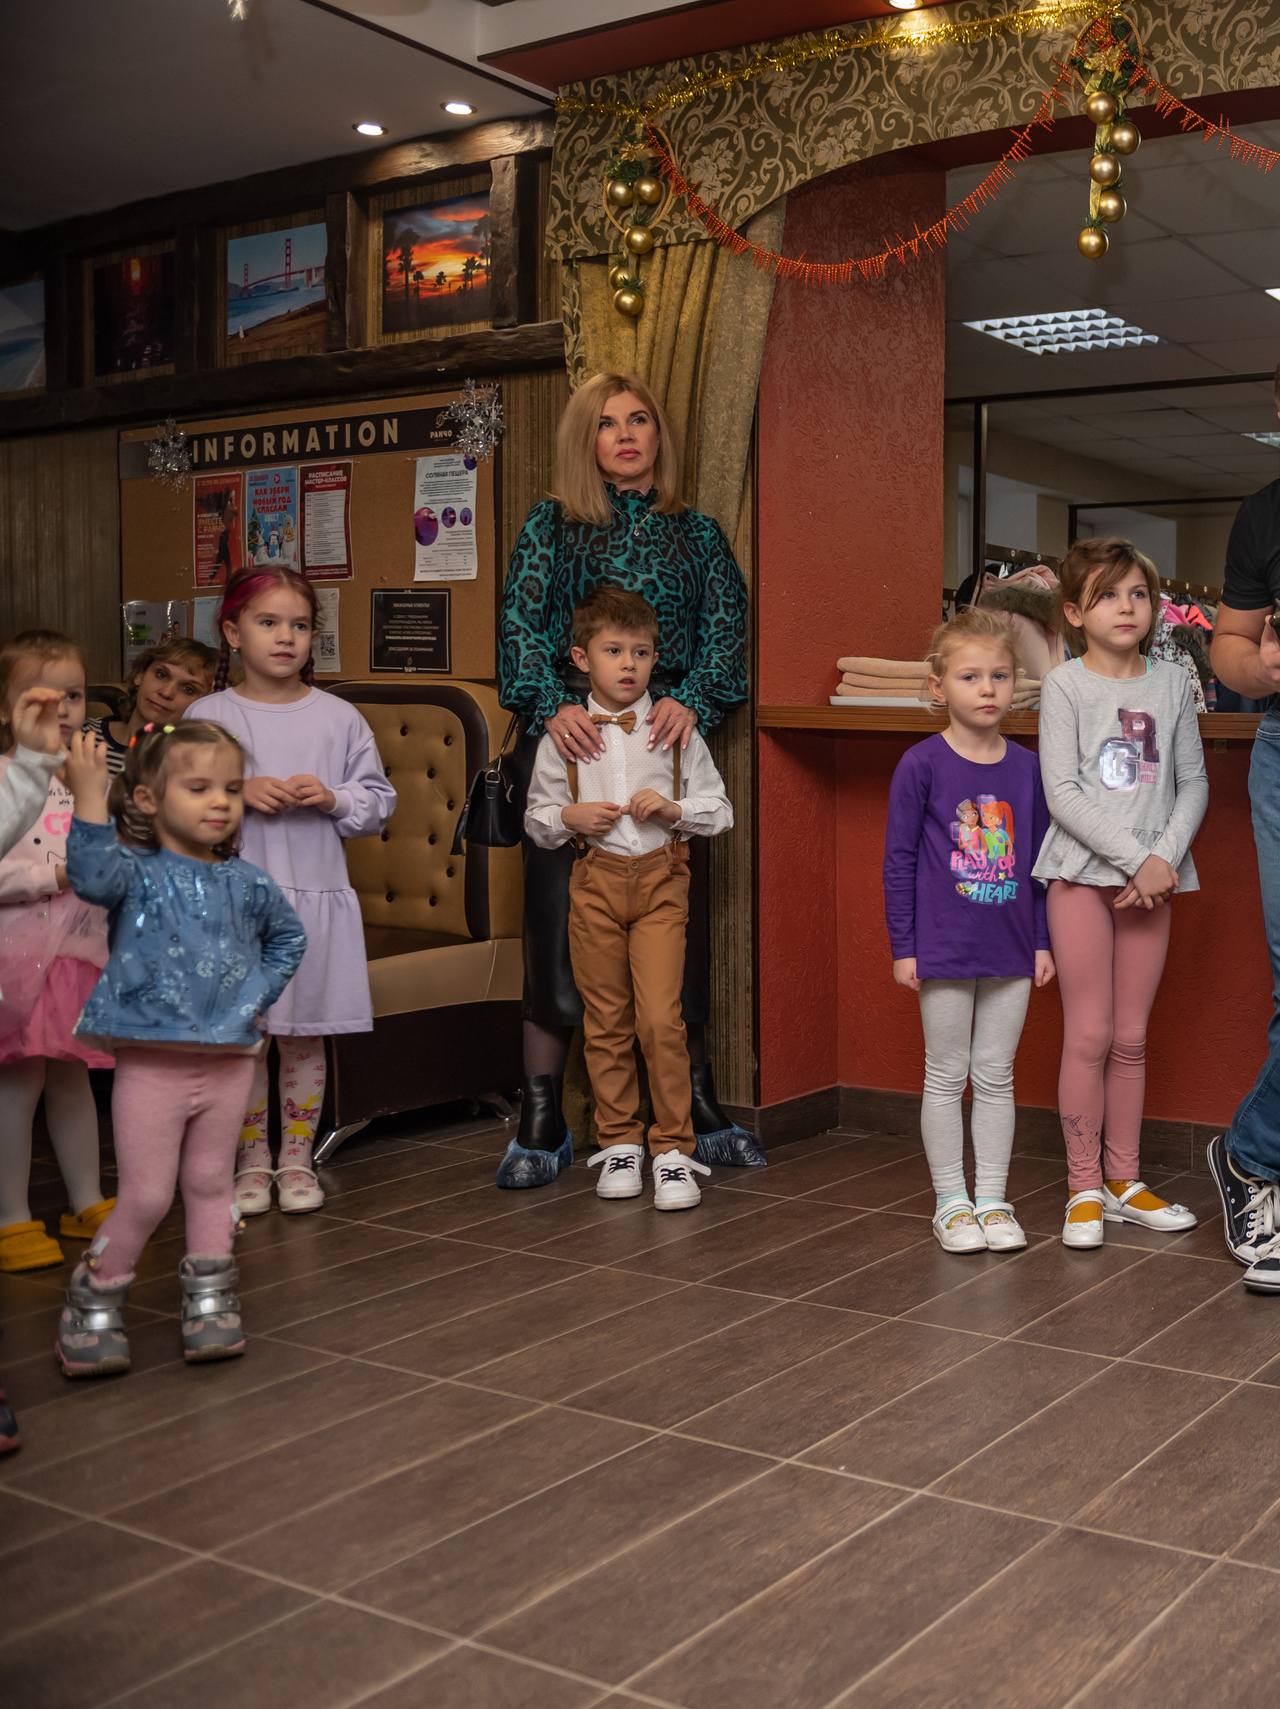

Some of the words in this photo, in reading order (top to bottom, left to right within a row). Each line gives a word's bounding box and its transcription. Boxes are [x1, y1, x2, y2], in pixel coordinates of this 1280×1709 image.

[430, 430, 453, 438] РАНЧО
[192, 417, 399, 463] INFORMATION
[308, 470, 344, 479] РАСПИСАНИЕ
[425, 471, 448, 479] СОЛЯНАЯ
[449, 469, 469, 477] ПЕЩЕРА
[304, 476, 348, 485] МАСТЕР-КЛАССОВ
[254, 488, 268, 496] КАК
[269, 486, 289, 495] ЗВЕРИ
[252, 494, 277, 506] НОВЫЙ
[278, 496, 292, 504] ГОД
[257, 504, 288, 514] СПАСАЛИ
[197, 517, 223, 526] ВМЕСТЕ
[203, 524, 226, 533] РАНЧО
[950, 850, 988, 871] PLAY
[968, 864, 998, 883] with
[971, 880, 1019, 904] HEART
